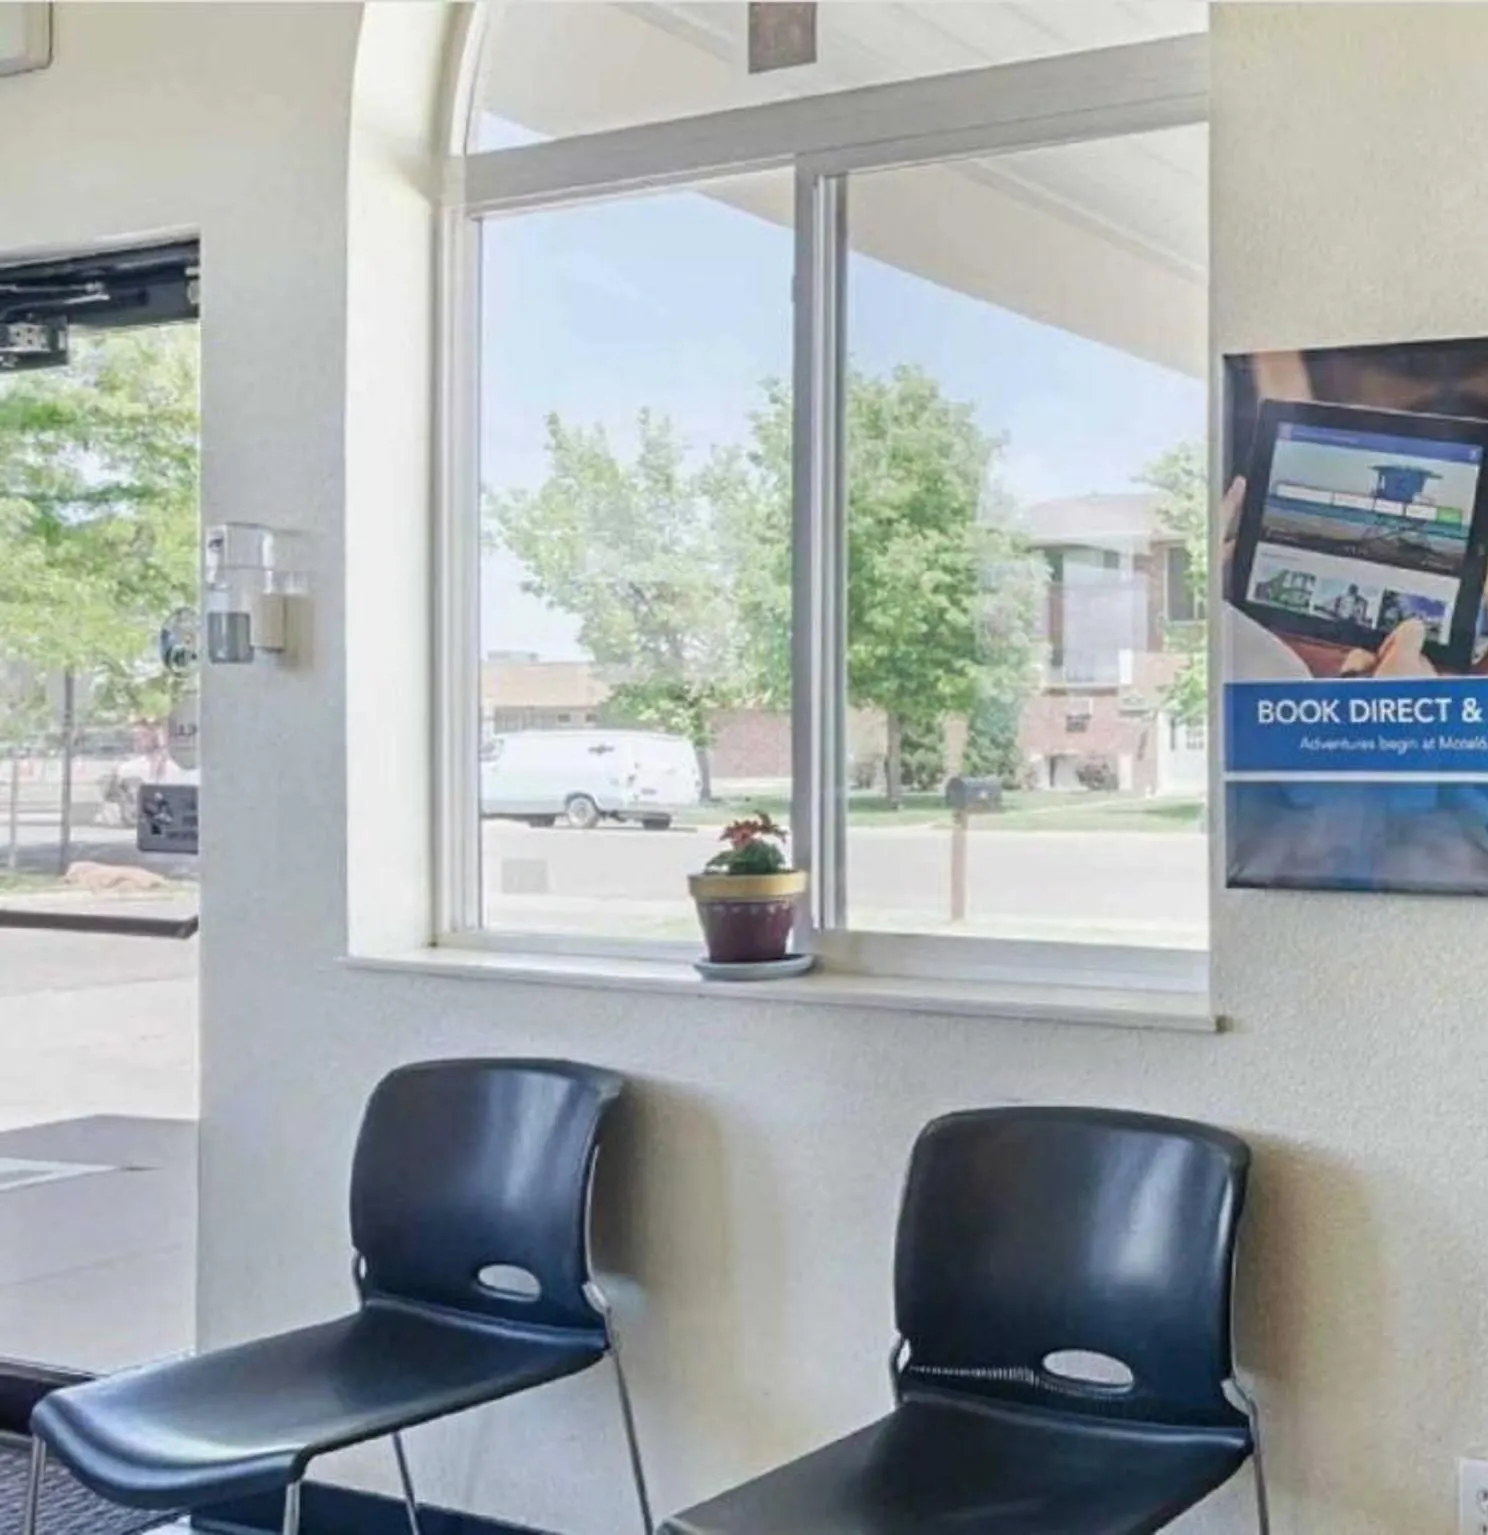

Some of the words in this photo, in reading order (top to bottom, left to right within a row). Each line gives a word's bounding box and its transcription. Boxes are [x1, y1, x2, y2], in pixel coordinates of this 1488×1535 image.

[1257, 699, 1341, 724] BOOK
[1350, 698, 1452, 724] DIRECT
[1461, 698, 1483, 723] &
[1299, 735, 1376, 751] Adventures
[1378, 734, 1419, 755] begin
[1422, 735, 1437, 750] at
